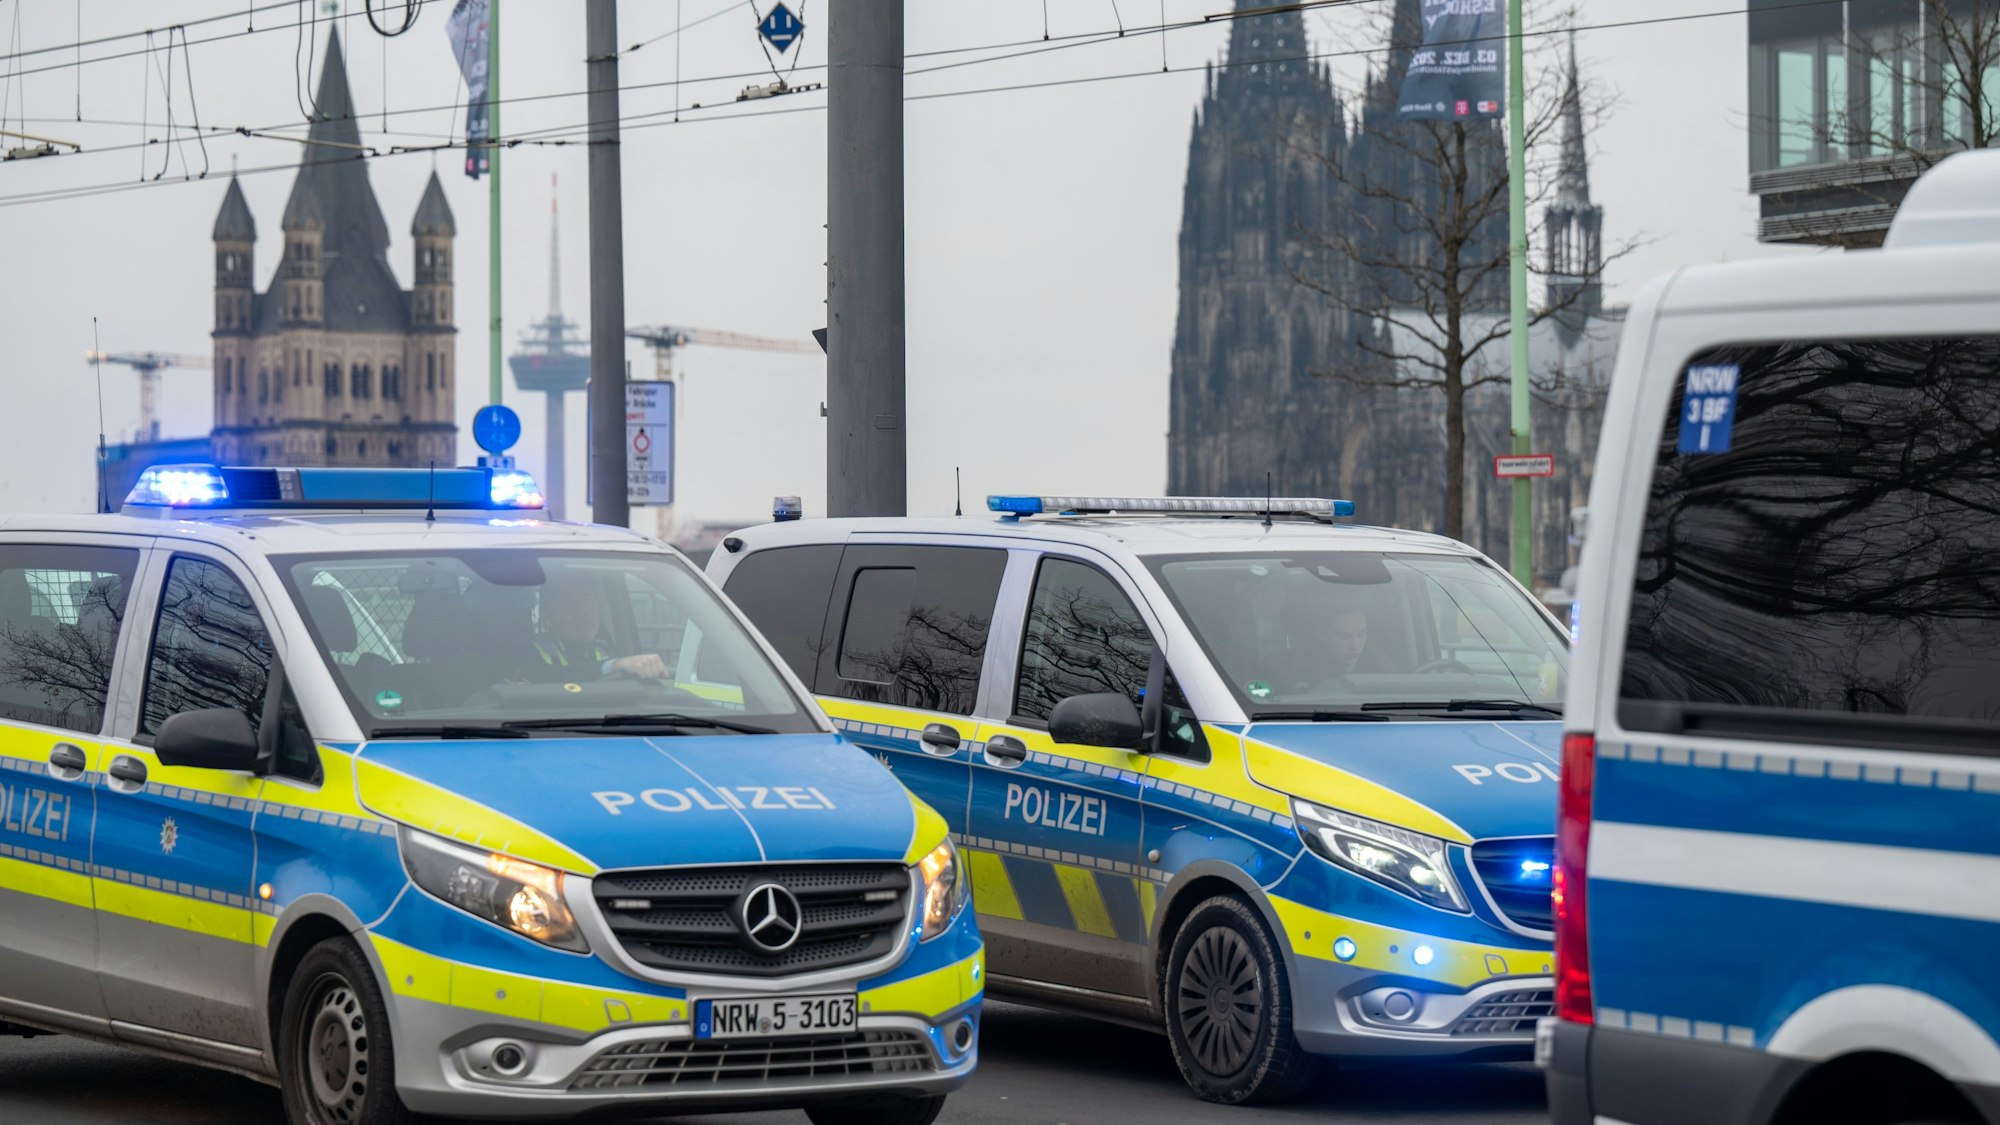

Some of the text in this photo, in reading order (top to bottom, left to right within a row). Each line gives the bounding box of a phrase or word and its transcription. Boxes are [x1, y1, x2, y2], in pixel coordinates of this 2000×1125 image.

[1686, 366, 1738, 394] NRW
[1452, 762, 1562, 785] POL
[0, 782, 71, 842] LIZEI
[591, 787, 837, 815] POLIZEI
[1004, 783, 1107, 836] POLIZEI
[712, 999, 855, 1033] NRW 5-3103
